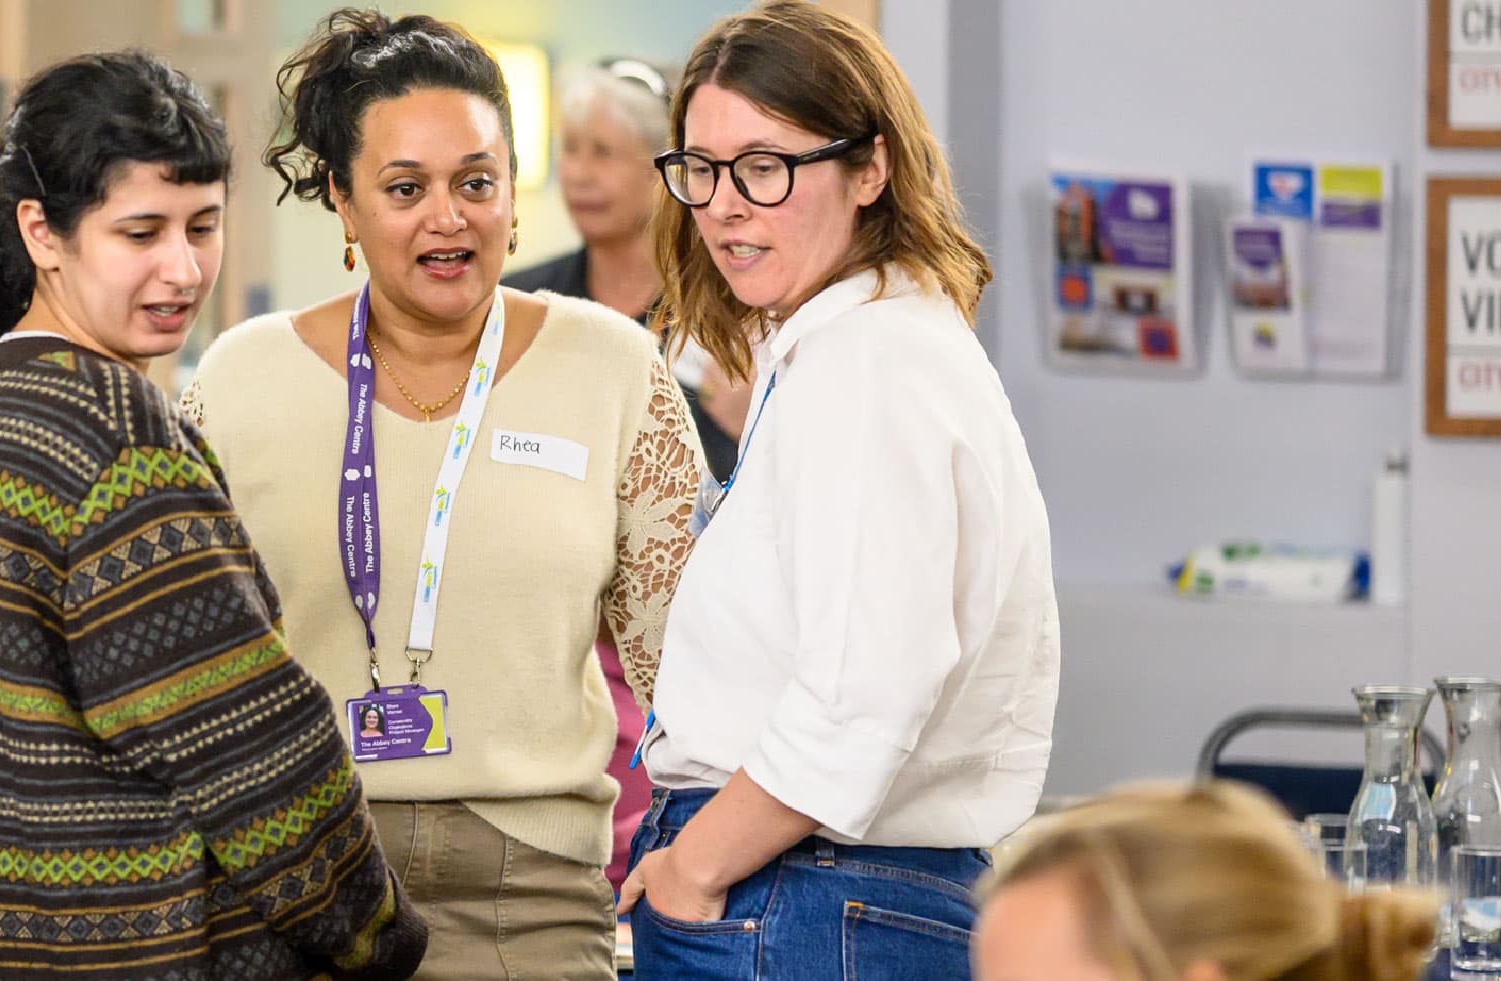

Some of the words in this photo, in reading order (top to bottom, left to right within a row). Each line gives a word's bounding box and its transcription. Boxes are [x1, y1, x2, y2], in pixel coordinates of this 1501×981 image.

[359, 383, 368, 398] The
[354, 398, 367, 424] Abbey
[351, 425, 364, 454] Centre
[500, 434, 540, 454] Rhea
[346, 495, 355, 513] The
[362, 492, 371, 522] Centre
[345, 513, 354, 543] Abbey
[364, 523, 375, 554] Abbey
[346, 544, 356, 578] Centre
[365, 555, 375, 574] The
